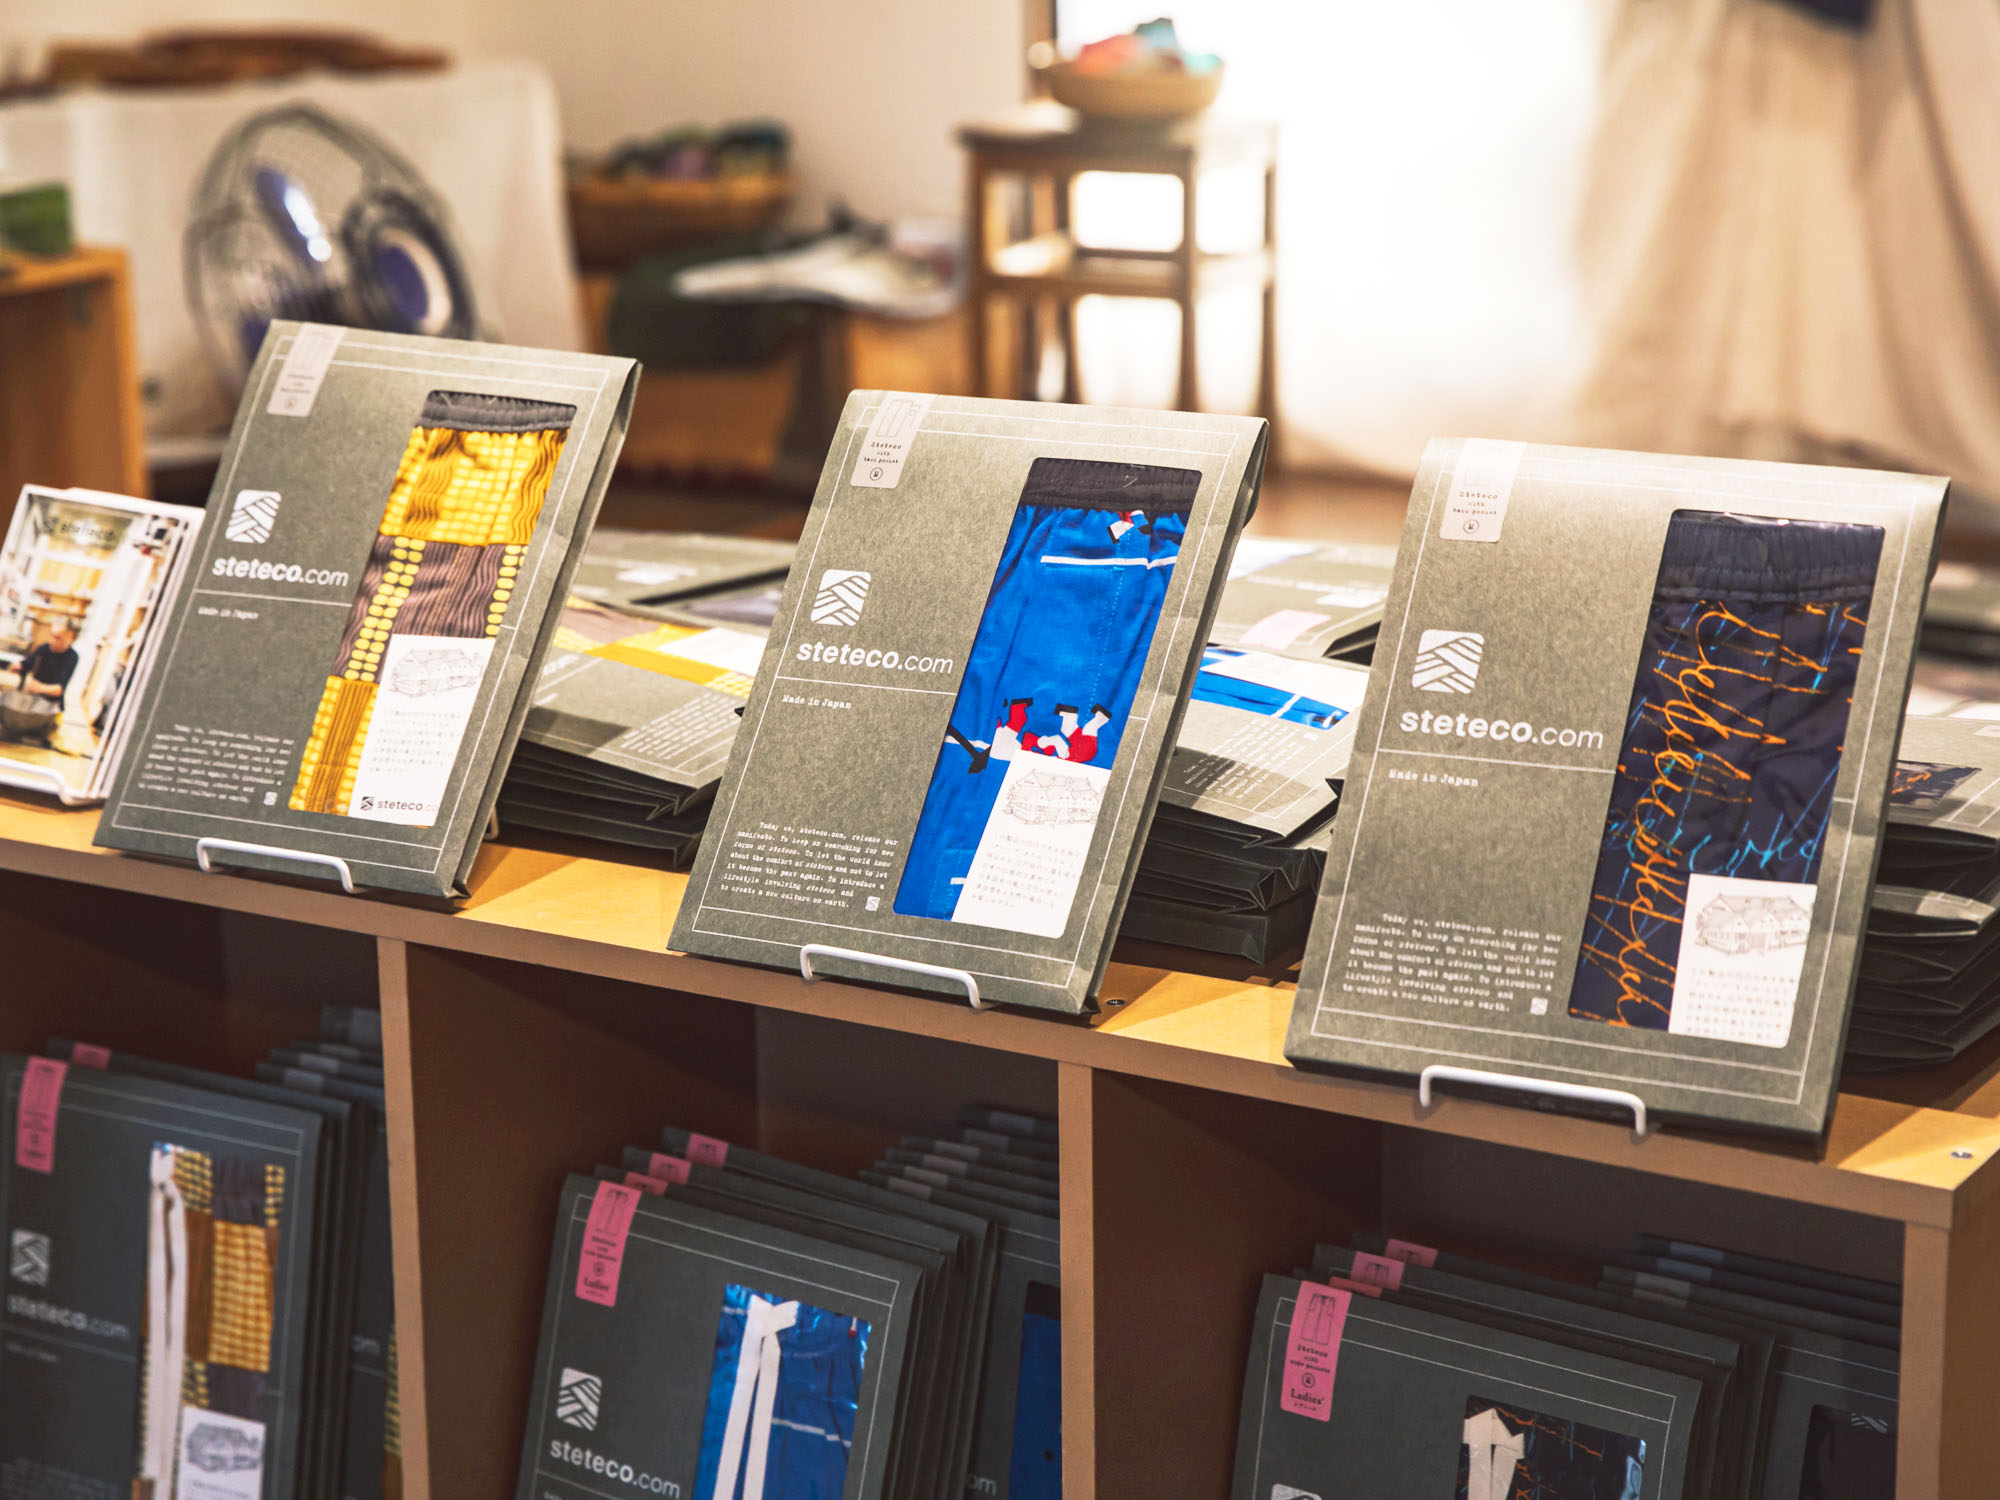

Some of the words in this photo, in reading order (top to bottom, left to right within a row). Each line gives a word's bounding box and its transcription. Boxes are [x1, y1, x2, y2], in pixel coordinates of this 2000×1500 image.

[212, 556, 349, 587] steteco.com
[796, 641, 953, 674] steteco.com
[782, 694, 805, 705] Made
[808, 696, 819, 706] in
[822, 697, 852, 709] Japan
[1400, 709, 1604, 749] steteco.com
[1388, 768, 1418, 781] Made
[1422, 771, 1437, 783] in
[1440, 773, 1479, 787] Japan
[737, 831, 775, 840] manifesto.
[792, 837, 809, 846] keep
[824, 842, 861, 854] searching
[865, 847, 878, 855] for
[760, 821, 779, 831] Today
[800, 827, 846, 840] steteco.com,
[852, 834, 880, 843] release
[769, 846, 800, 855] steteco.
[817, 851, 830, 859] let
[850, 857, 870, 865] world
[874, 859, 892, 867] know
[805, 862, 833, 871] steteco
[724, 873, 759, 883] lifestyle
[765, 879, 801, 891] involving
[806, 885, 836, 894] steteco
[738, 864, 762, 872] become
[800, 873, 823, 881] again.
[840, 878, 876, 888] introduce
[731, 886, 756, 894] create
[781, 893, 810, 902] culture
[824, 900, 849, 908] earth.
[550, 1439, 681, 1500] steteco.com
